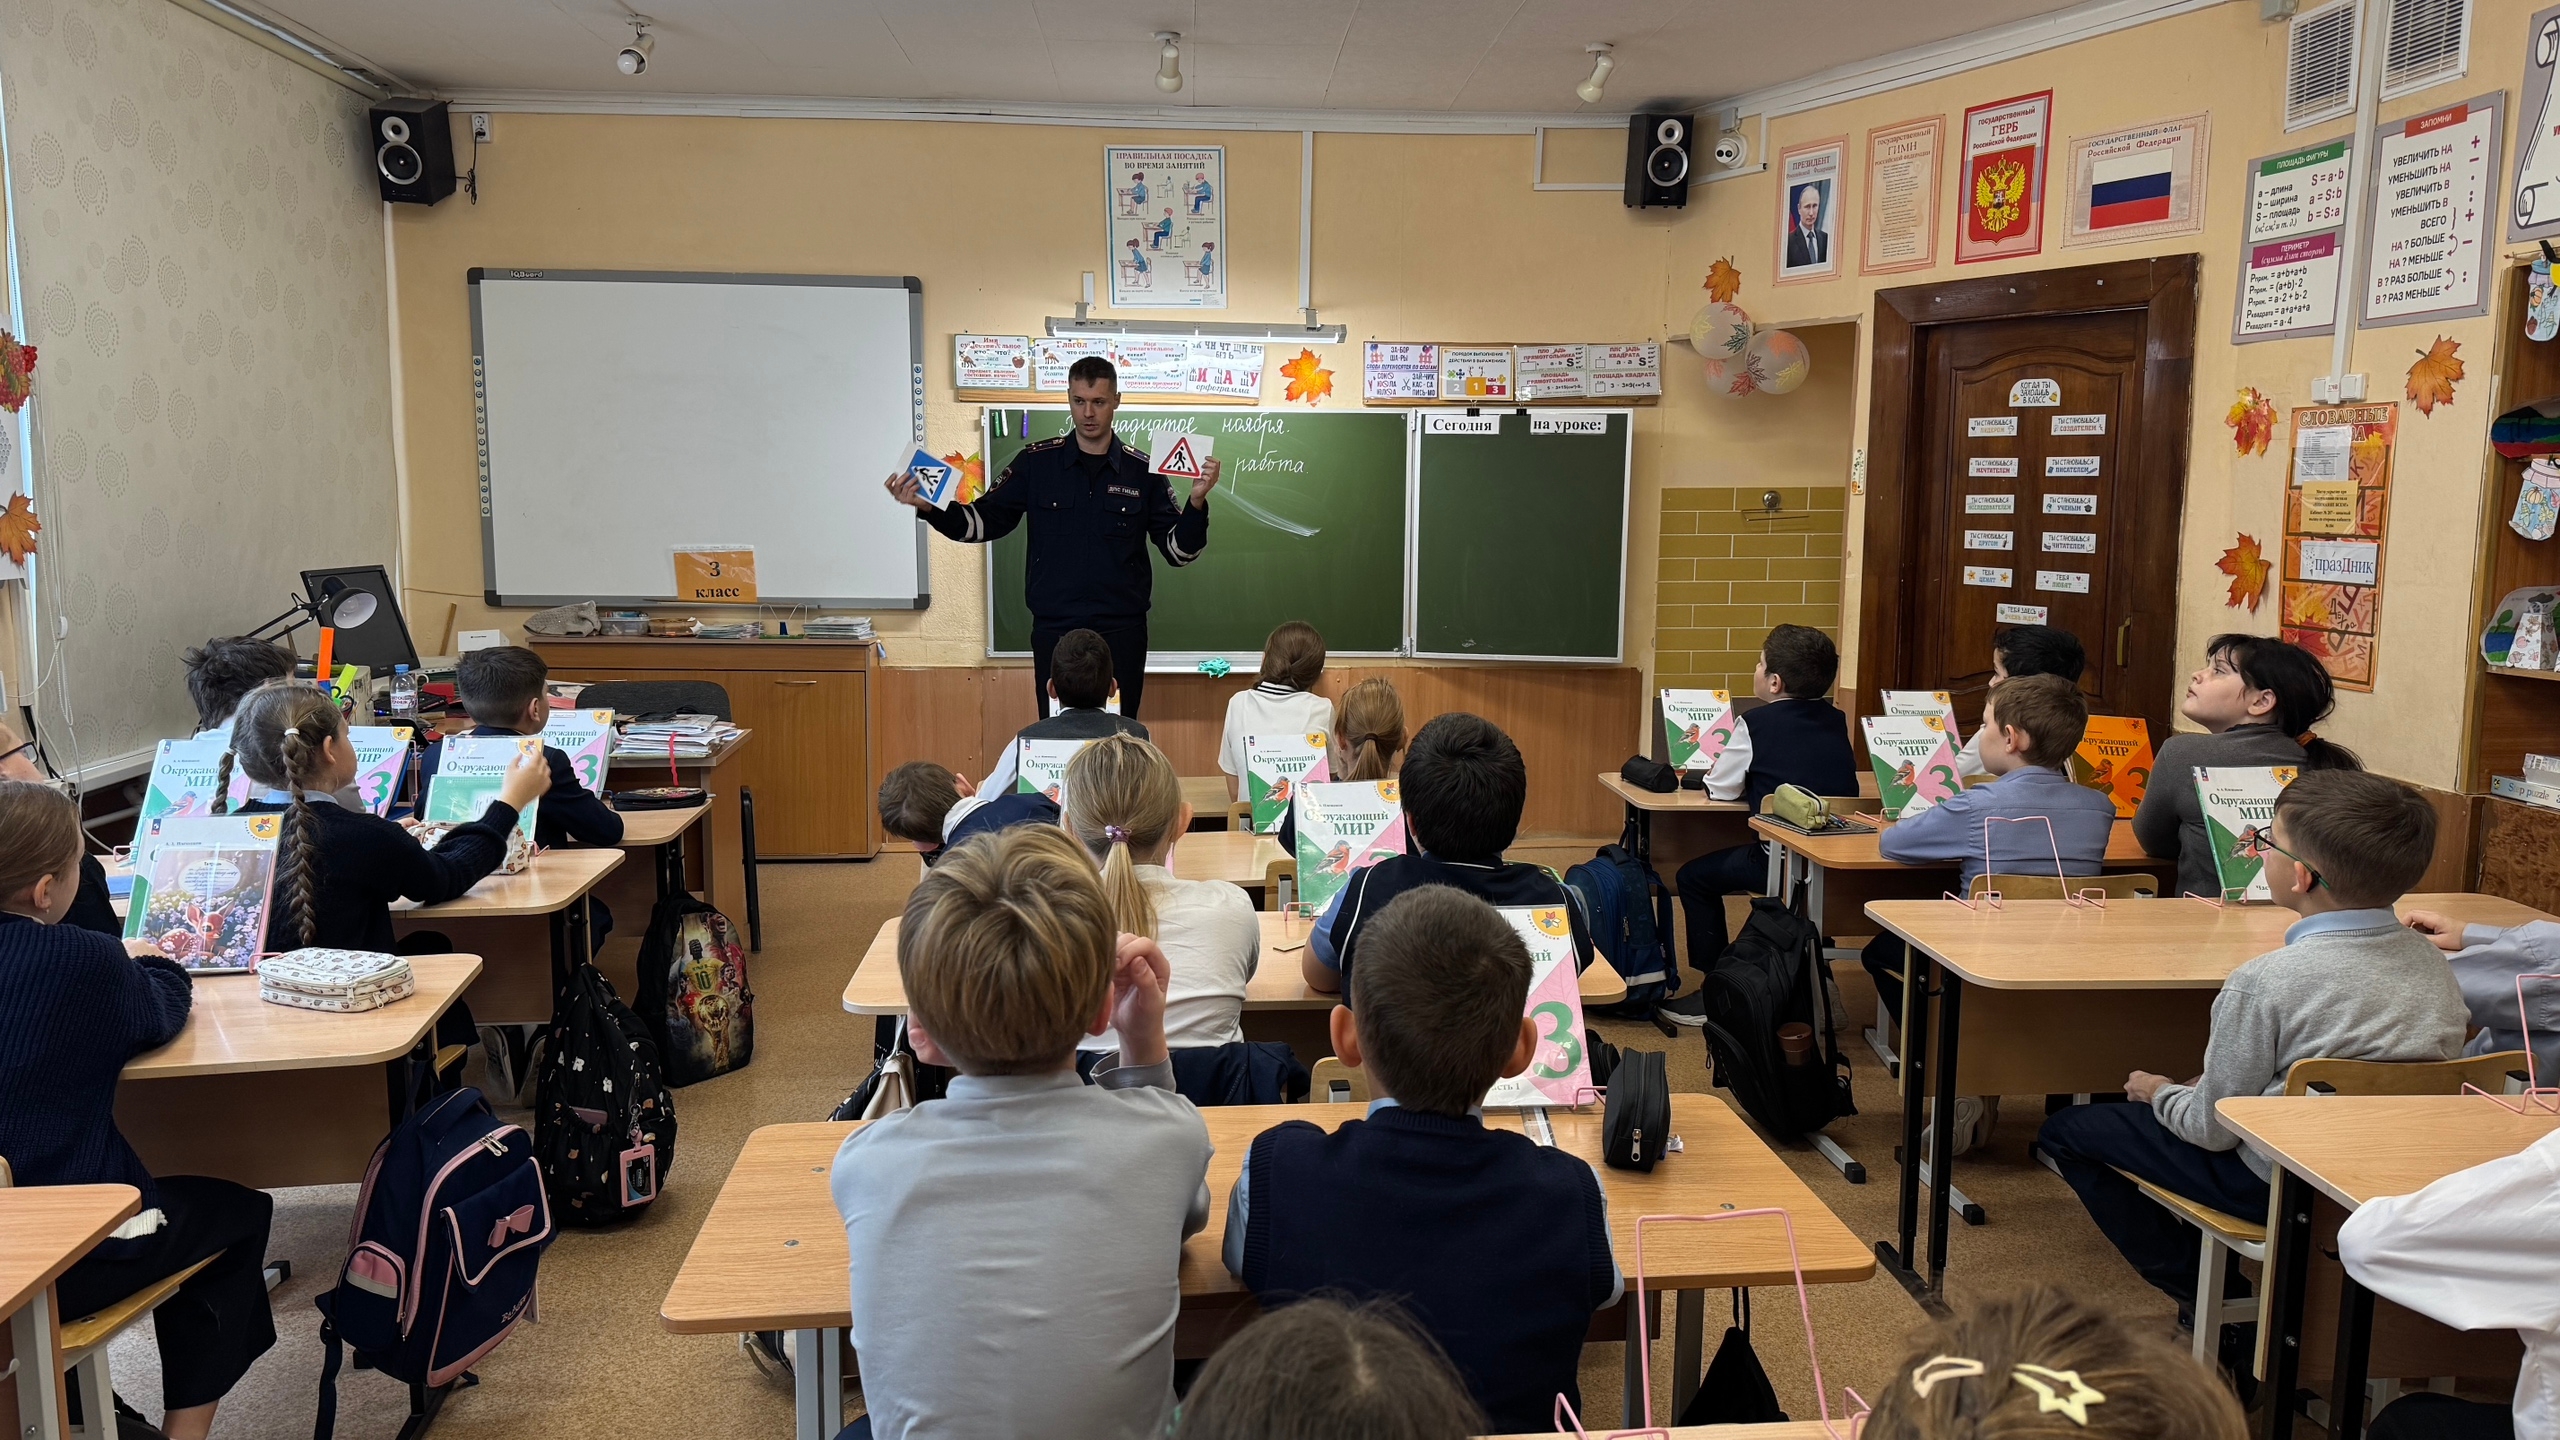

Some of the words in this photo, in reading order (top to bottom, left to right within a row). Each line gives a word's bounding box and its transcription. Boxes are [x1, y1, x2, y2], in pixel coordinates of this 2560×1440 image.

[1978, 106, 2036, 127] государственный
[2420, 113, 2452, 130] ЗАПОМНИ
[1991, 121, 2019, 137] ГЕРБ
[1973, 136, 2005, 150] Российской
[2006, 131, 2037, 145] Федерации
[2088, 127, 2158, 149] ГОСУДАРСТВЕННЫЙ
[2162, 124, 2182, 134] ФЛАГ
[1888, 141, 1917, 156] ГИМН
[2087, 143, 2131, 158] Российской
[2136, 134, 2182, 151] Федерации
[1116, 152, 1172, 160] ПРАВИЛЬНАЯ
[1174, 152, 1213, 160] ПОСАДКА
[2276, 156, 2306, 170] ПЛОЩАДЬ
[2306, 149, 2330, 164] ФИГУРЫ
[2393, 147, 2440, 168] УВЕЛИЧИТЬ
[2440, 143, 2453, 155] НА
[1165, 161, 1205, 170] ЗАНЯТИЙ
[1792, 156, 1831, 170] ПРЕЗИДЕНТ
[2388, 166, 2438, 185] УМЕНЬШИТЬ
[2439, 161, 2452, 173] НА
[2311, 174, 2318, 187] S
[2270, 184, 2293, 197] длина
[2395, 181, 2443, 201] УВЕЛИЧИТЬ
[2443, 179, 2450, 190] В
[2270, 194, 2299, 209] ширина
[2390, 200, 2441, 219] УМЕНЬШИТЬ
[2442, 198, 2449, 208] В
[2256, 212, 2262, 222] S
[2269, 207, 2301, 220] площадь
[2307, 210, 2314, 223] b
[2420, 215, 2447, 229] ВСЕГО
[2281, 241, 2310, 253] ПЕРИМЕТР
[2391, 241, 2403, 252] НА
[2405, 239, 2409, 249] ?
[2410, 233, 2446, 248] БОЛЬШЕ
[2389, 259, 2401, 269] НА
[2402, 257, 2407, 267] ?
[2408, 251, 2444, 266] МЕНЬШЕ
[2377, 278, 2383, 287] В
[2384, 276, 2389, 287] ?
[2390, 272, 2406, 285] РАЗ
[2407, 268, 2443, 283] БОЛЬШЕ
[2375, 295, 2381, 304] В
[2382, 293, 2387, 303] ?
[2388, 290, 2404, 302] РАЗ
[2405, 286, 2441, 301] МЕНЬШЕ
[1205, 341, 1217, 350] ЧН
[1220, 342, 1231, 351] ЧТ
[1566, 358, 1575, 367] S
[1638, 357, 1647, 366] S
[1197, 367, 1208, 383] И
[1223, 370, 1233, 385] А
[1250, 372, 1259, 387] У
[1453, 384, 1460, 392] 2
[1473, 382, 1479, 390] 1
[1492, 386, 1499, 394] 3
[2020, 381, 2040, 389] КОГДА
[2041, 381, 2051, 389] ТЫ
[2020, 389, 2050, 397] ЗАХОДИШЬ
[2028, 396, 2046, 404] КЛАСС
[2299, 406, 2389, 426] СЛОВАРНЫЕ
[1433, 418, 1492, 432] Сегодня
[1533, 420, 1550, 430] на
[1554, 419, 1602, 434] уроке:
[2051, 542, 2085, 550] ЧИТАТЕЛЕМ
[709, 561, 720, 577] 3
[695, 587, 740, 598] класс
[1668, 704, 1722, 713] Окружающий
[1687, 712, 1714, 721] МИР
[554, 737, 586, 747] МИР
[1873, 736, 1939, 748] Окружающий
[1898, 745, 1929, 756] МИР
[2097, 745, 2129, 756] МИР
[1252, 754, 1316, 765] Окружающий
[575, 754, 599, 788] 3
[1276, 762, 1307, 773] МИР
[363, 771, 392, 807] 3
[1929, 764, 1962, 805] 3
[1334, 822, 1375, 835] МИР
[695, 970, 711, 991] 10
[1530, 1001, 1582, 1079] 3
